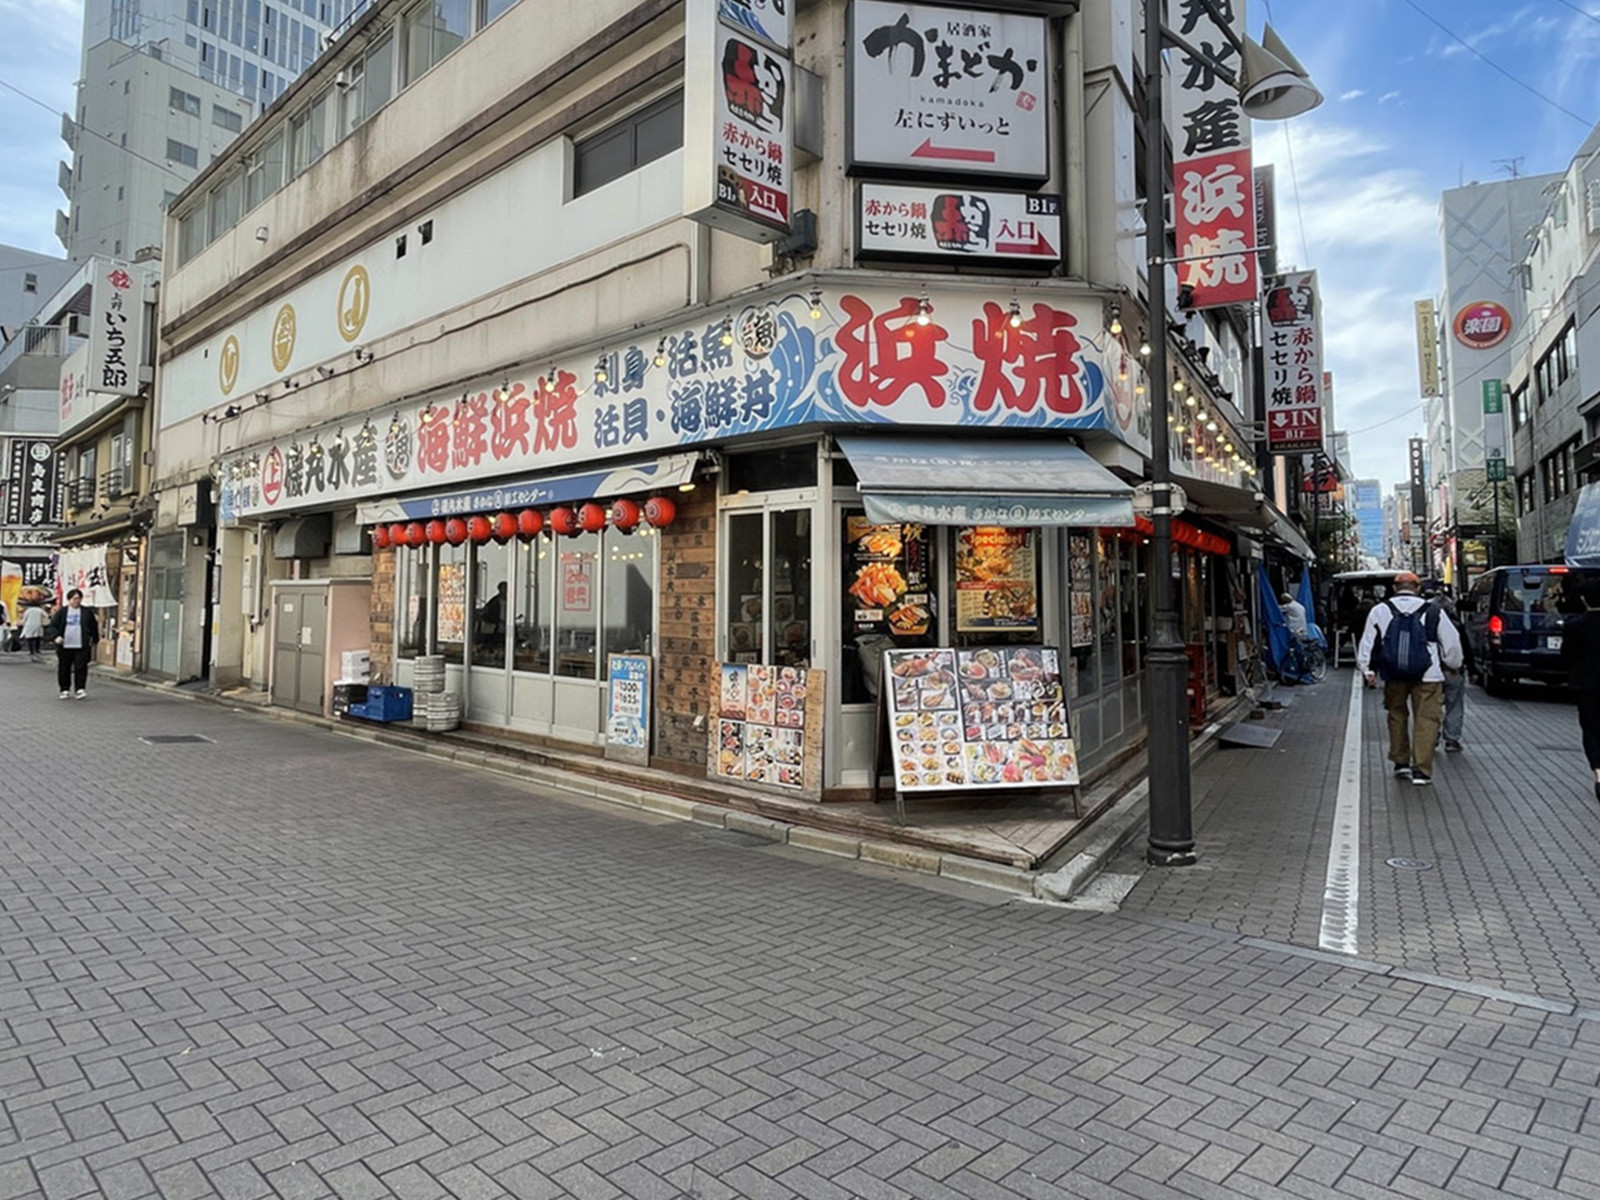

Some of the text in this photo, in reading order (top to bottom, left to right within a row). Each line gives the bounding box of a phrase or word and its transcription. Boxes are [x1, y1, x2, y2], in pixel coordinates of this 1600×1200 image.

[862, 12, 1038, 94] かまどか
[722, 122, 784, 165] 赤から鍋
[894, 108, 1011, 136] 左にずいっと
[722, 146, 784, 186] セセリ焼
[749, 185, 777, 211] 入口
[865, 199, 927, 219] 赤から鍋
[1181, 164, 1249, 288] 浜焼
[865, 220, 927, 240] セセリ焼
[996, 218, 1036, 240] 入口
[102, 311, 128, 389] いち五郎
[593, 345, 649, 398] 刺身
[667, 323, 734, 380] 活魚
[835, 295, 1084, 415] 浜焼
[1269, 330, 1293, 406] セセリ焼
[1292, 327, 1317, 405] 赤から鍋
[417, 370, 579, 474] 海鮮浜焼
[1291, 409, 1318, 426] IN
[284, 424, 378, 498] 磯丸水産
[1412, 441, 1420, 485] HOTEL
